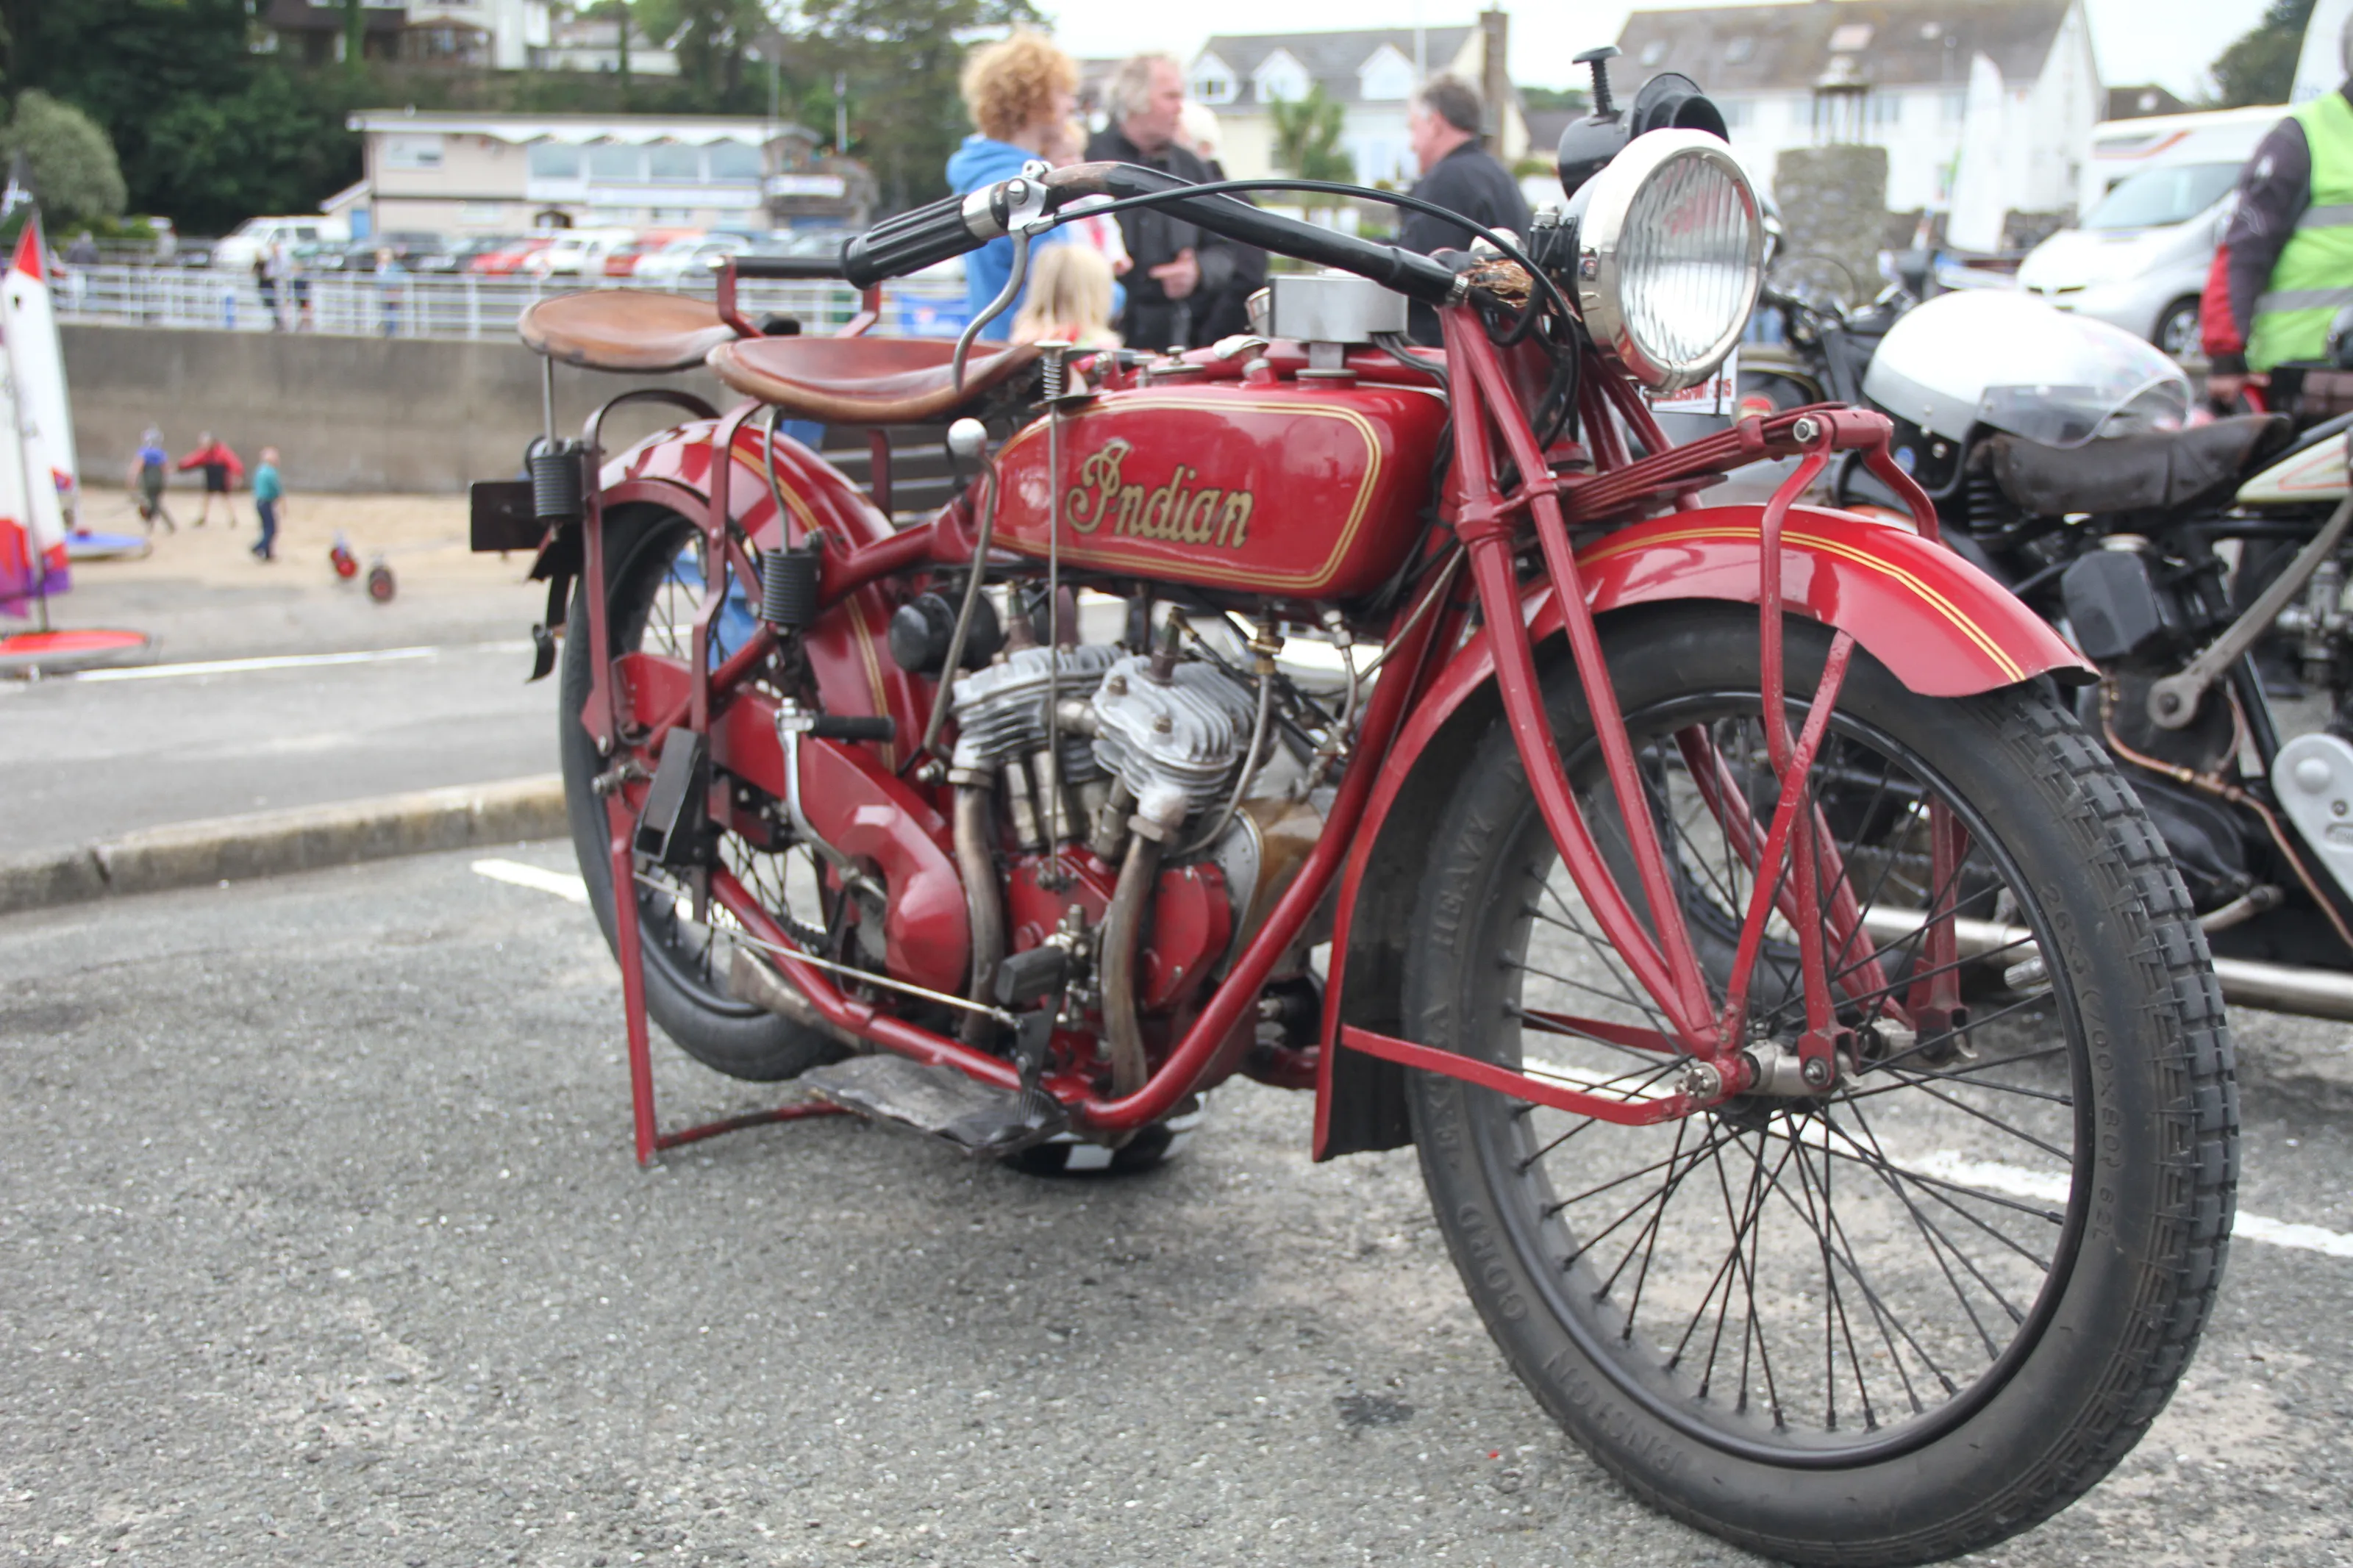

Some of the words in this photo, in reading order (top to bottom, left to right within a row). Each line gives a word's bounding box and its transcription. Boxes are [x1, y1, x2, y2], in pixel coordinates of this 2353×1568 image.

[1067, 437, 1254, 548] Indian
[1432, 813, 1495, 948] HEAVY
[1457, 1201, 1528, 1322] CORD
